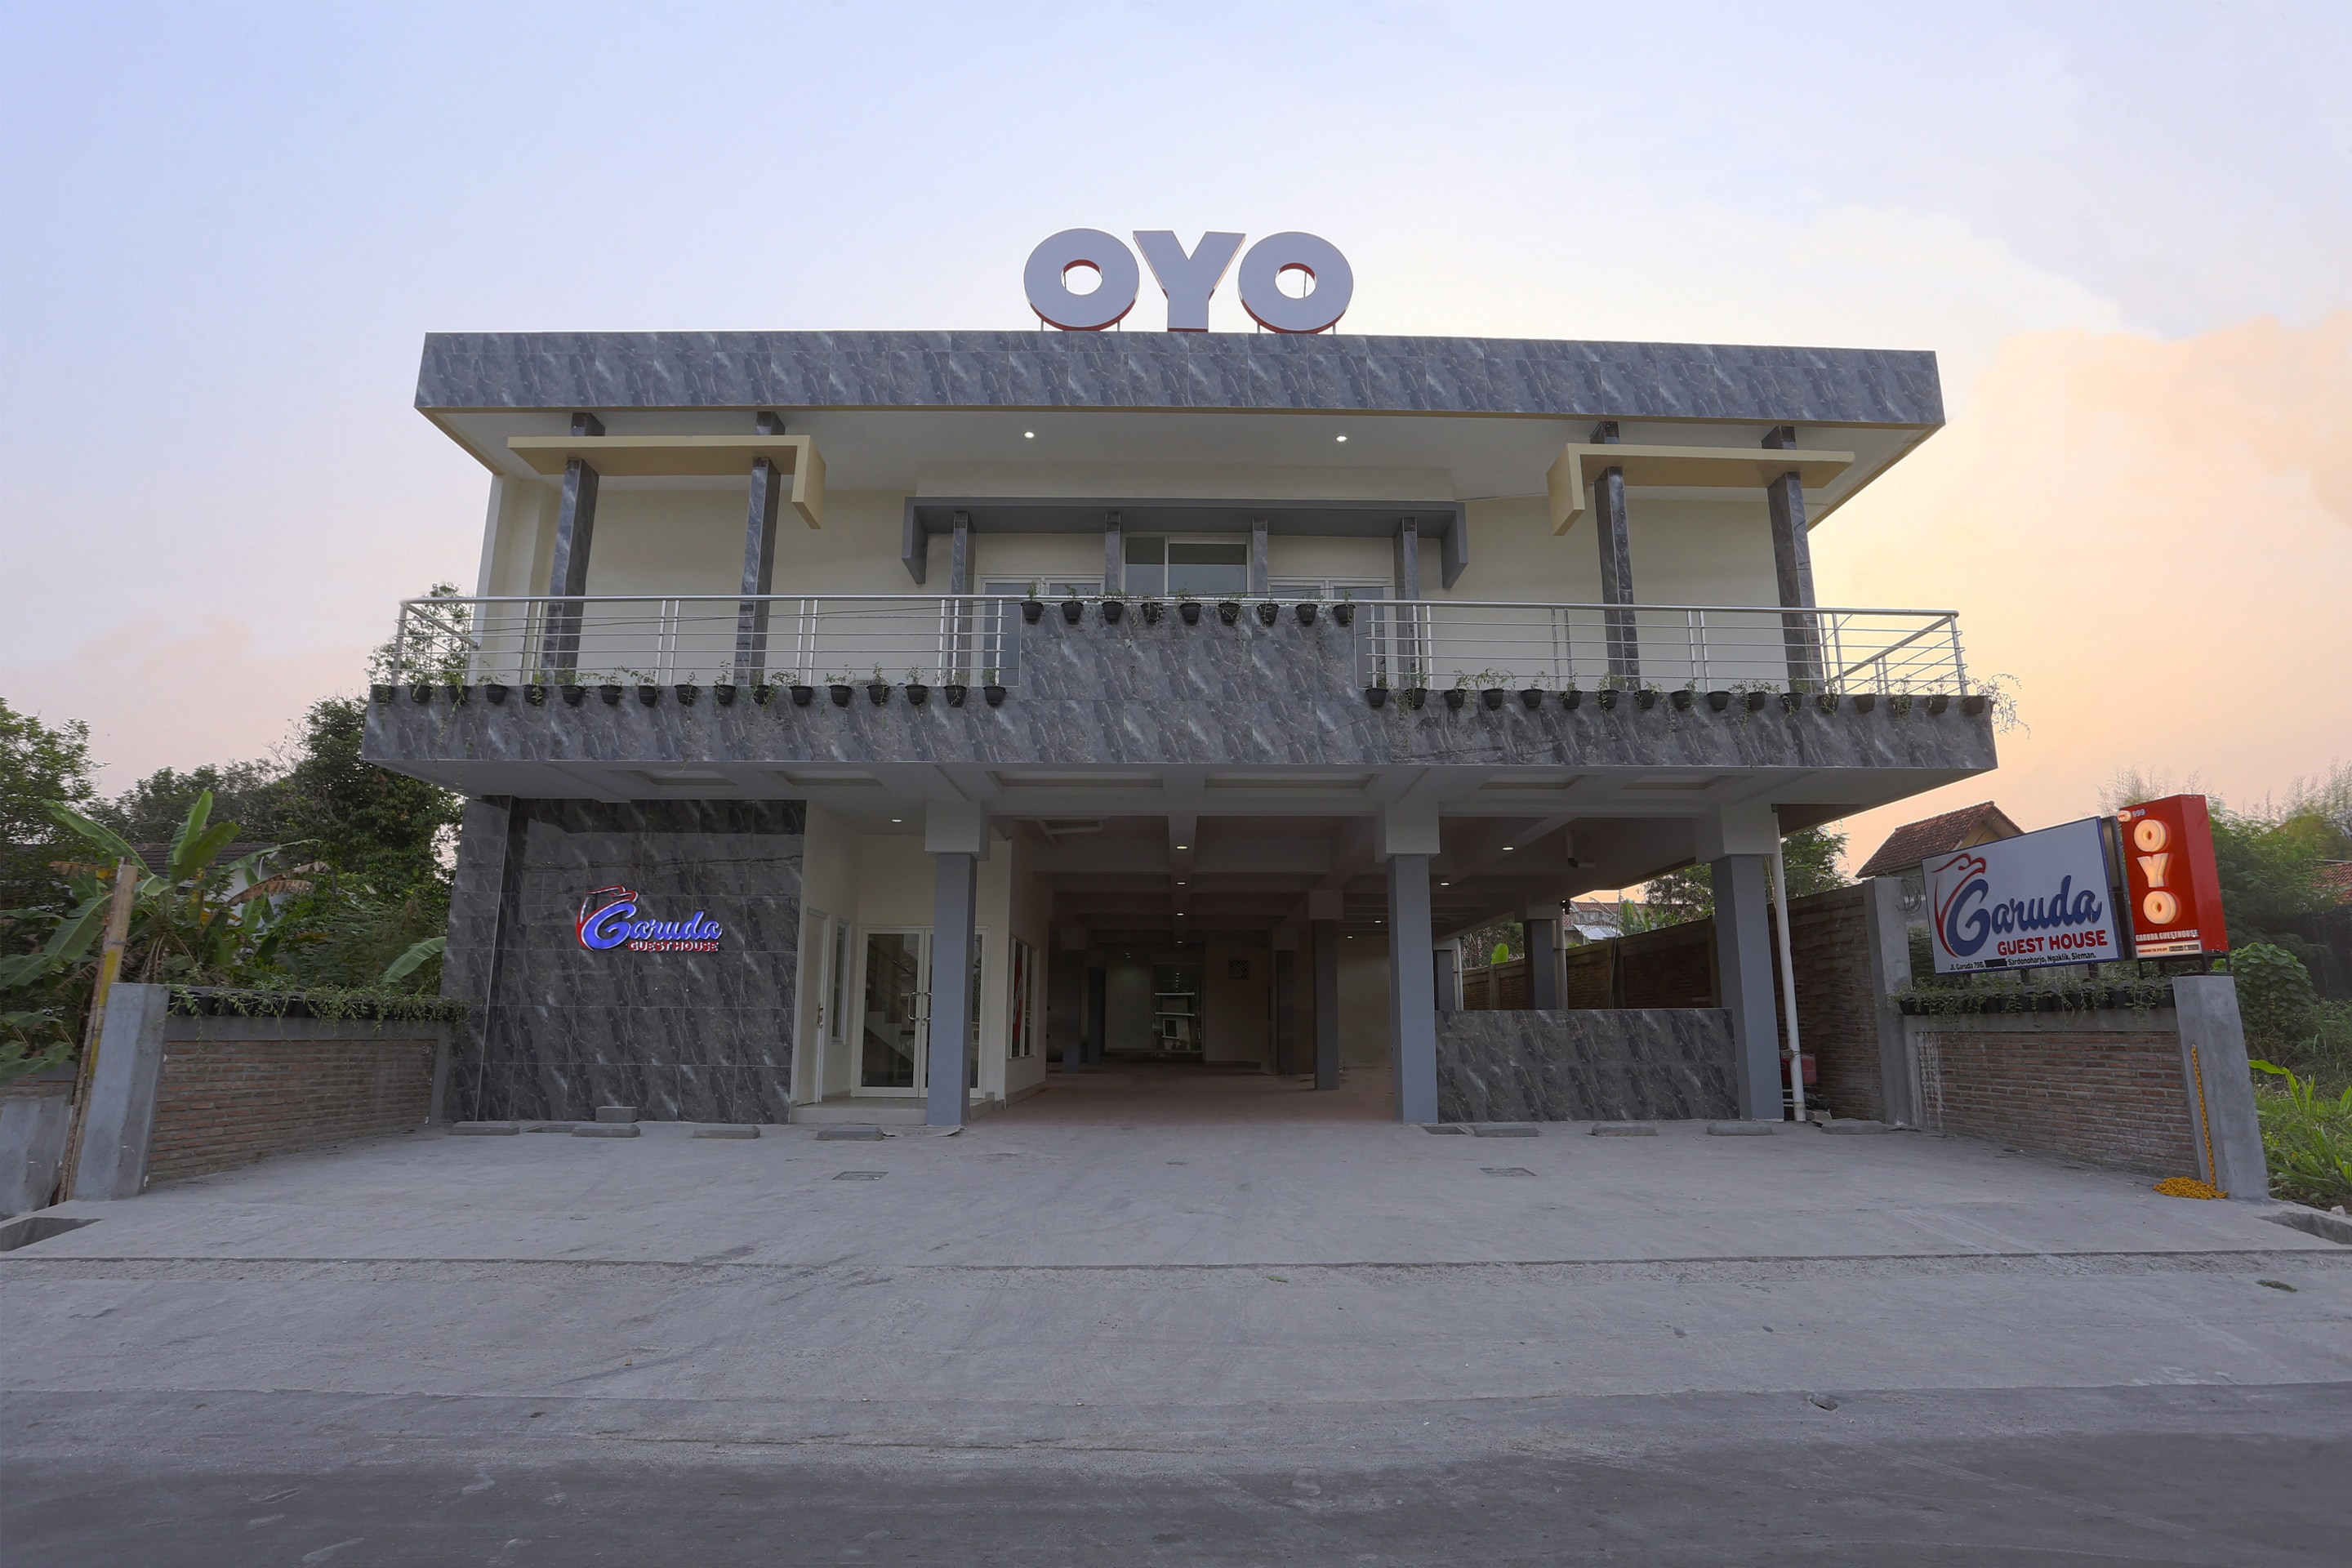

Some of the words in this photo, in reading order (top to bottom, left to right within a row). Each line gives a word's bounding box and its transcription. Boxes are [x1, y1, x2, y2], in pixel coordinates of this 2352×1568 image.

[1023, 227, 1354, 333] OYO
[2134, 818, 2178, 924] OYO
[581, 902, 724, 950] Garuda
[1946, 874, 2102, 956] Garuda
[626, 941, 672, 952] GUEST
[673, 941, 719, 951] HOUSE
[1997, 936, 2045, 956] GUEST
[2049, 929, 2109, 951] HOUSE
[2135, 933, 2158, 942] GARUDA
[2158, 929, 2198, 940] GUESTHOUSE
[1956, 962, 1973, 970] Garuda
[2071, 951, 2097, 960] Sleman.
